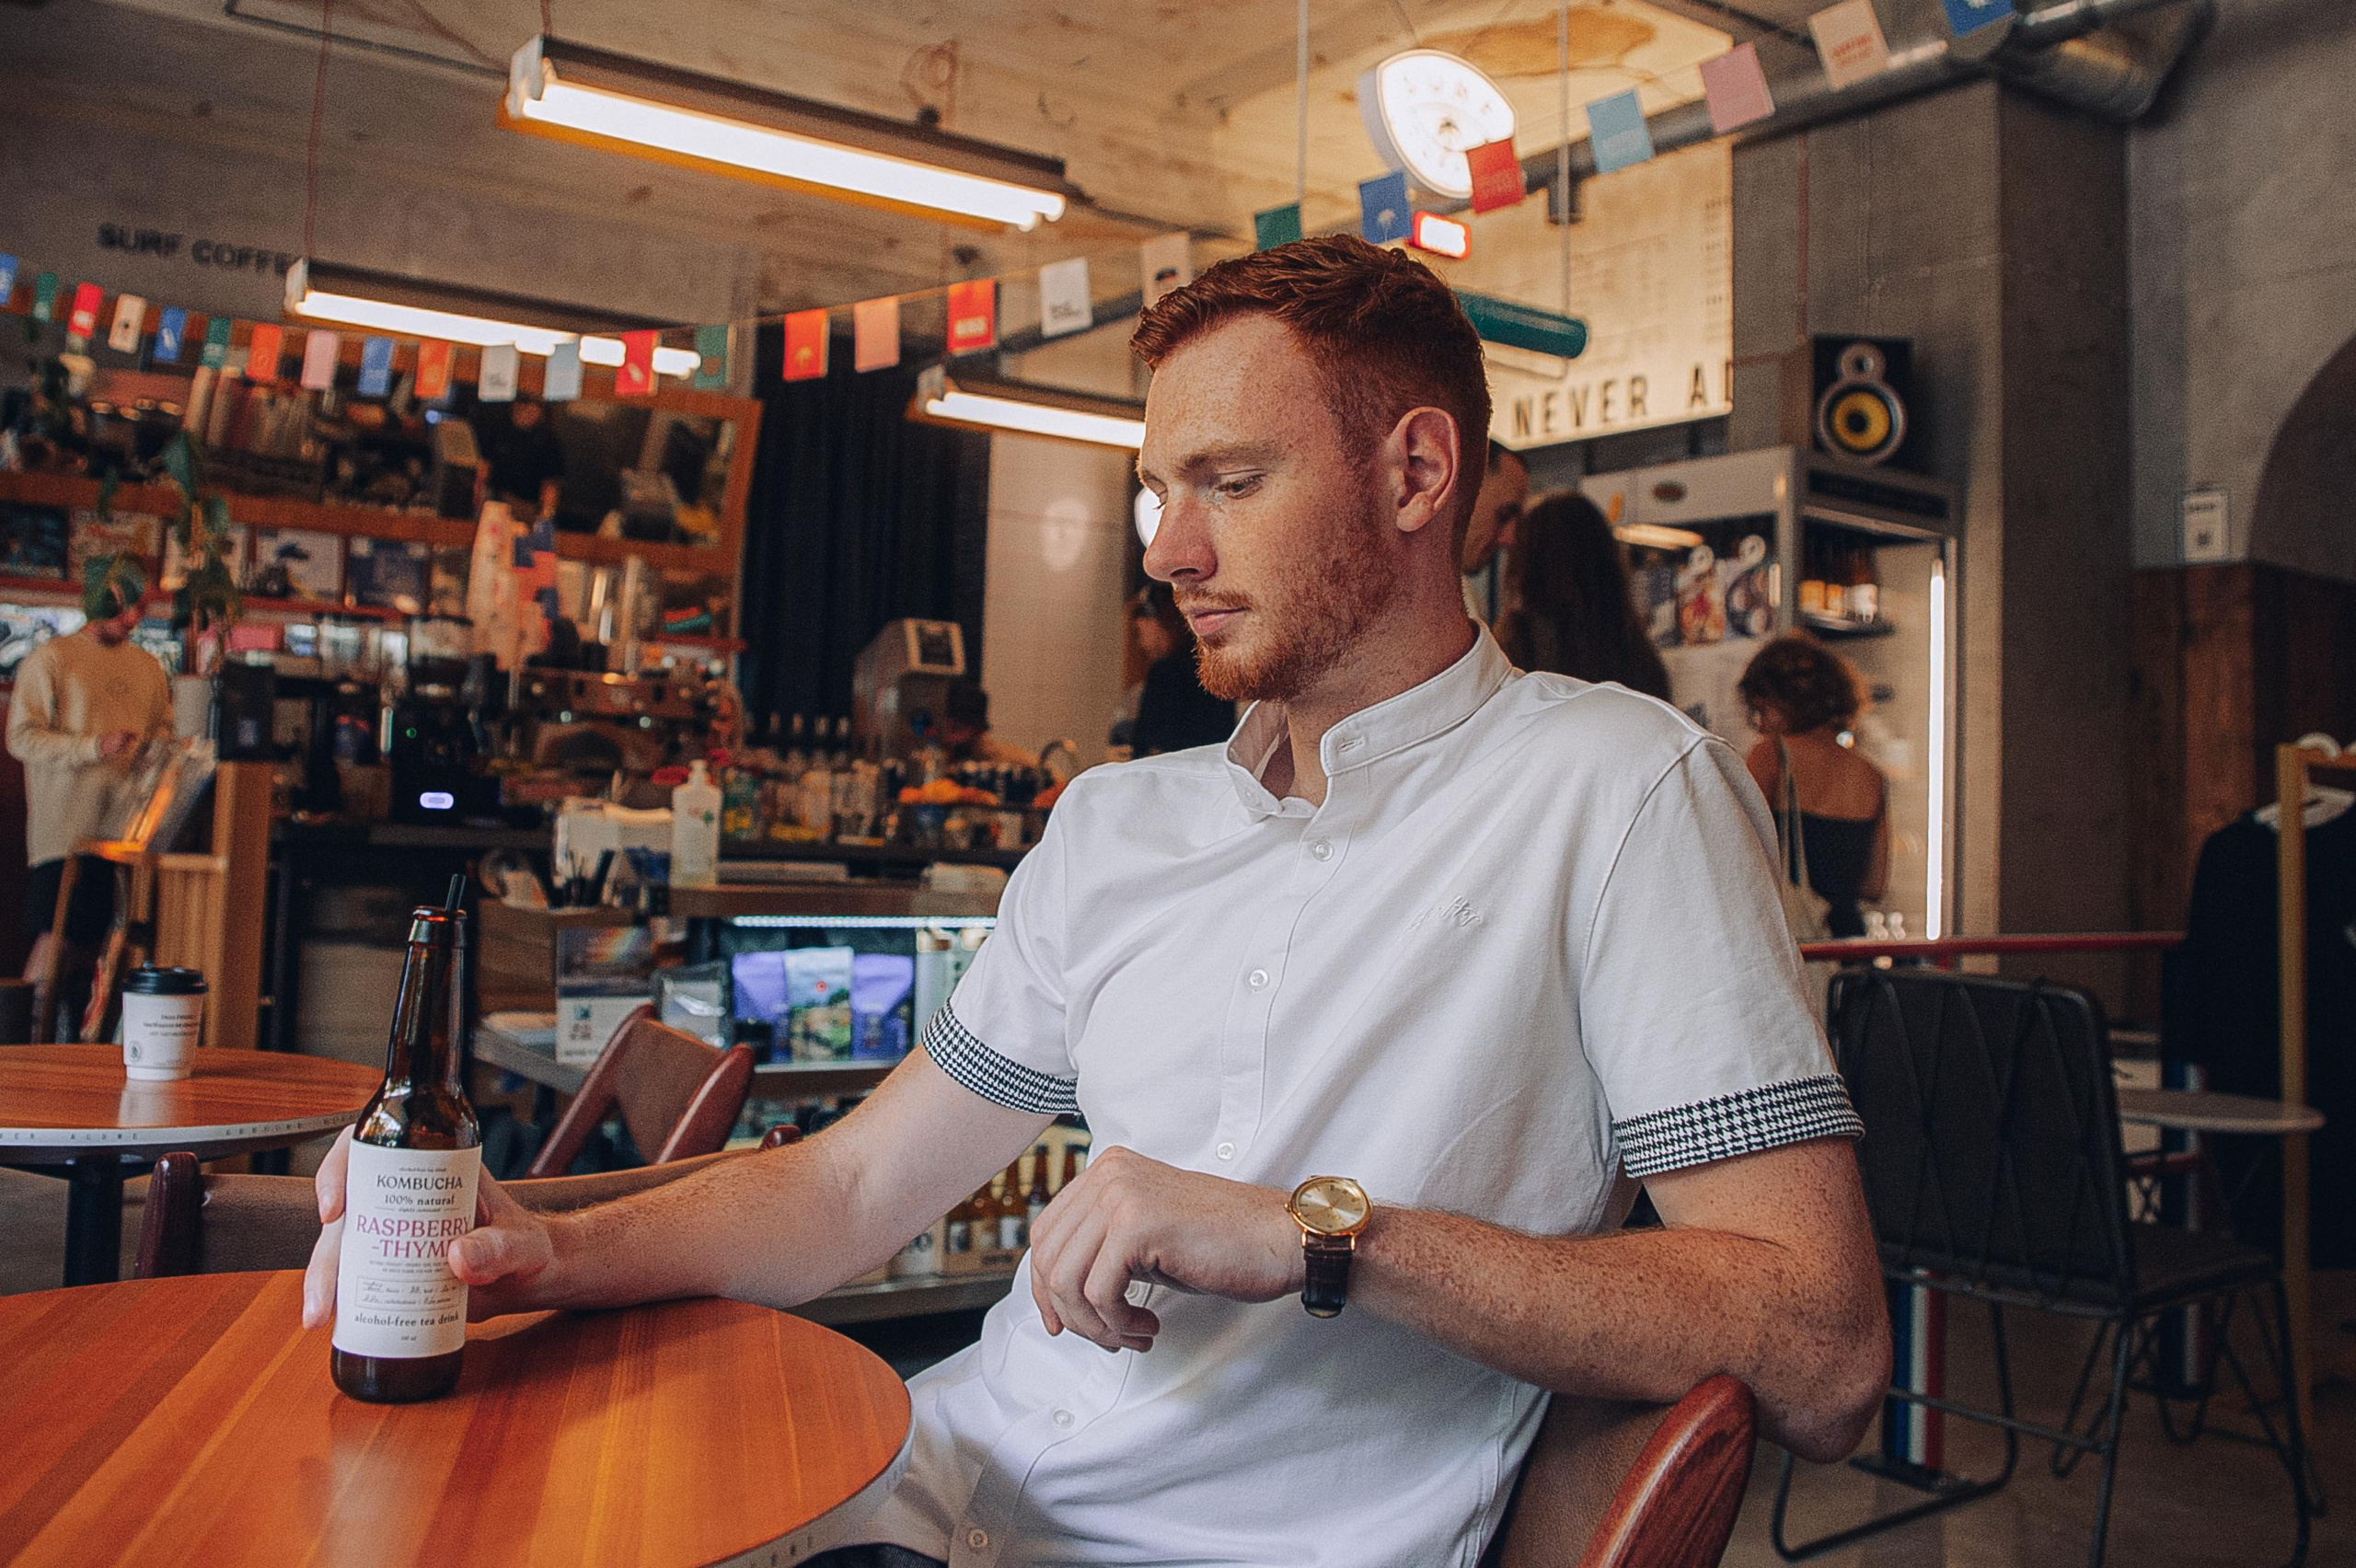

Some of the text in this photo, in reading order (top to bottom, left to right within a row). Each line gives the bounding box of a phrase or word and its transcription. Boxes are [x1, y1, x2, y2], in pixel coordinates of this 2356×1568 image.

[97, 223, 299, 277] SURF COFFE
[1512, 373, 1647, 437] NEVER
[376, 1174, 463, 1191] KOMBUCHA
[385, 1194, 456, 1205] 100% natural
[356, 1214, 471, 1238] RASPBERRY
[371, 1238, 453, 1259] -THYM
[354, 1310, 459, 1327] alcohol-free tea drink
